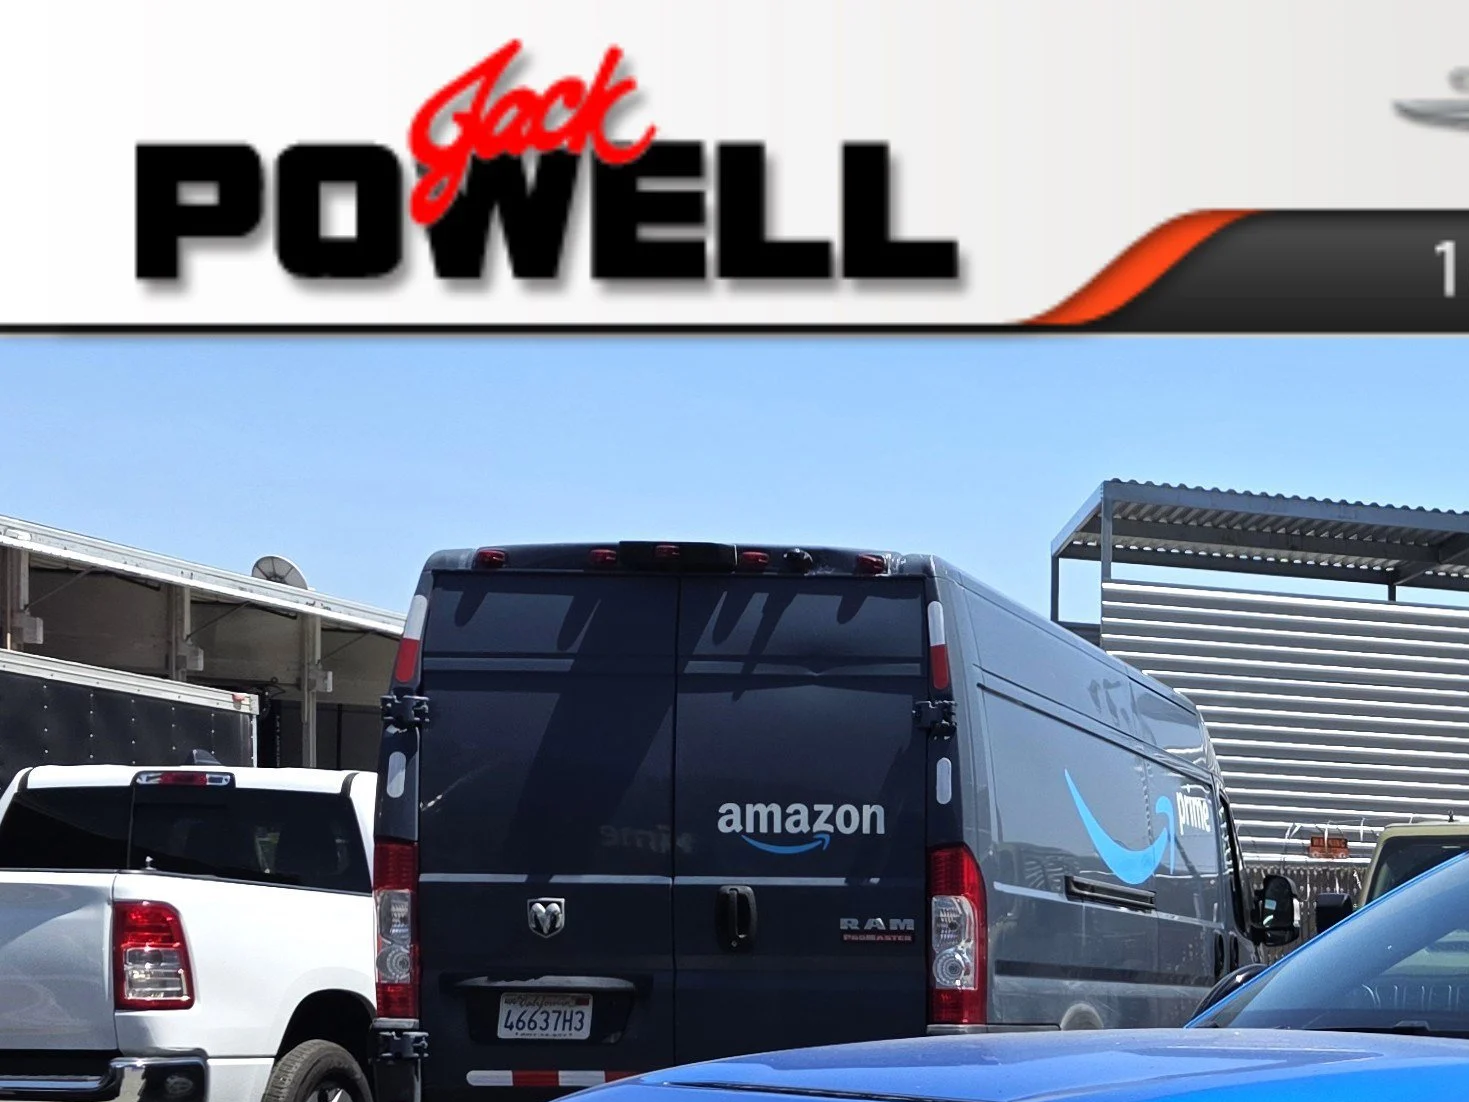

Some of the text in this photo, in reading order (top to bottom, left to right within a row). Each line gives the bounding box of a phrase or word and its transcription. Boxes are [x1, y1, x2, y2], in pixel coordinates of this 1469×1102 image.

[717, 802, 886, 835] amazon
[1176, 791, 1211, 836] prime
[839, 917, 915, 930] RAM
[503, 1009, 585, 1032] 46637H3
